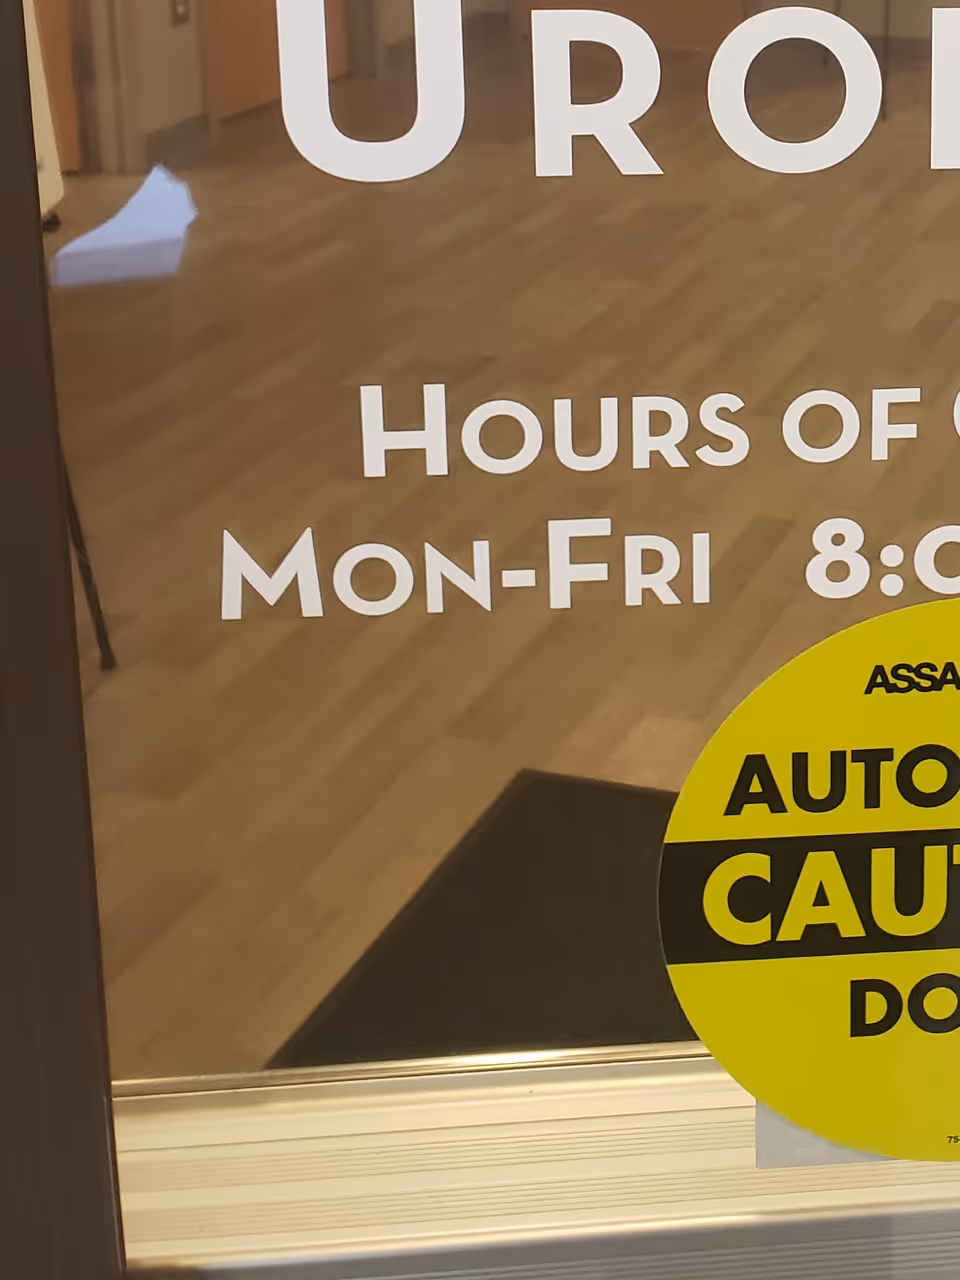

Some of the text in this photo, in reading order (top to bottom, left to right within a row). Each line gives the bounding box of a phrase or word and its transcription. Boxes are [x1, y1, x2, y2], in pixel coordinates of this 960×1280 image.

[360, 383, 750, 477] HOURS
[782, 387, 921, 463] OF
[221, 518, 710, 620] MON-FRI
